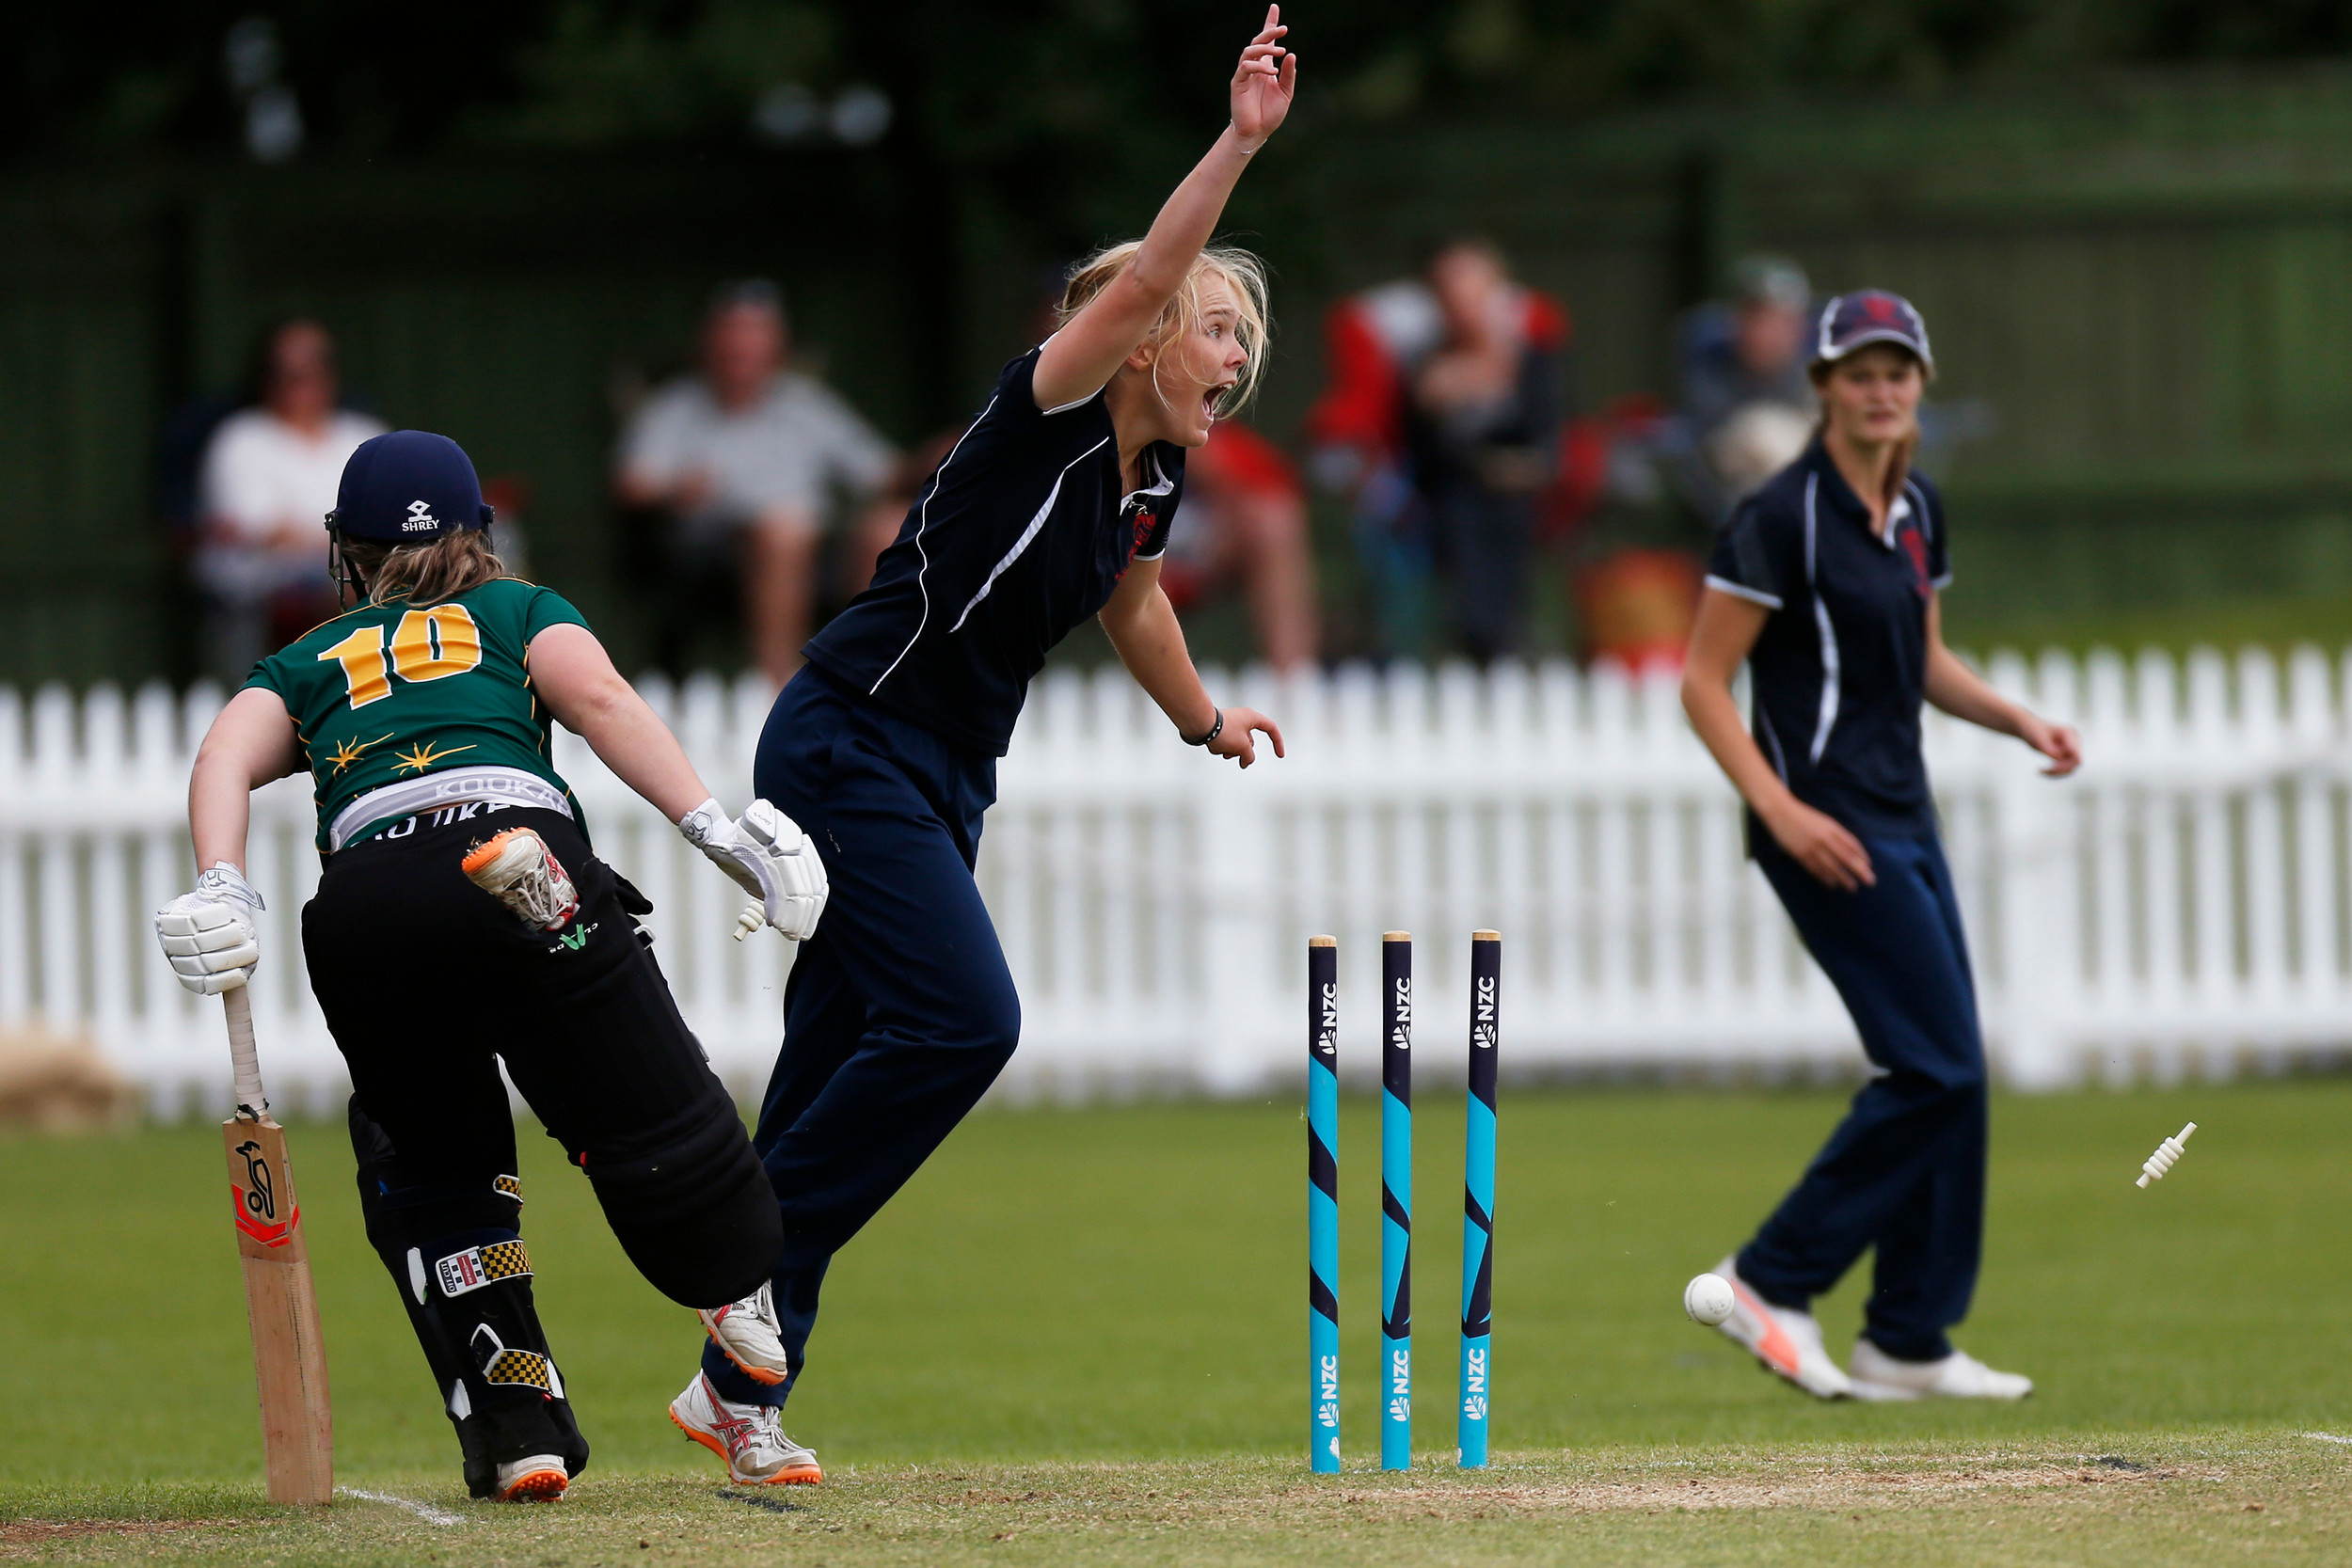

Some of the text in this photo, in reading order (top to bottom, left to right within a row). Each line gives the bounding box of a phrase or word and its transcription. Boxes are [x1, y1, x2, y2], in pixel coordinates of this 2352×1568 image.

[402, 519, 439, 531] SHREY
[317, 603, 482, 711] 10
[1322, 982, 1337, 1027] NZC
[1396, 977, 1410, 1022] NZC
[1477, 976, 1495, 1021] NZC
[1321, 1354, 1337, 1400] NZC
[1393, 1350, 1408, 1394] NZC
[1468, 1348, 1486, 1392] NZC
